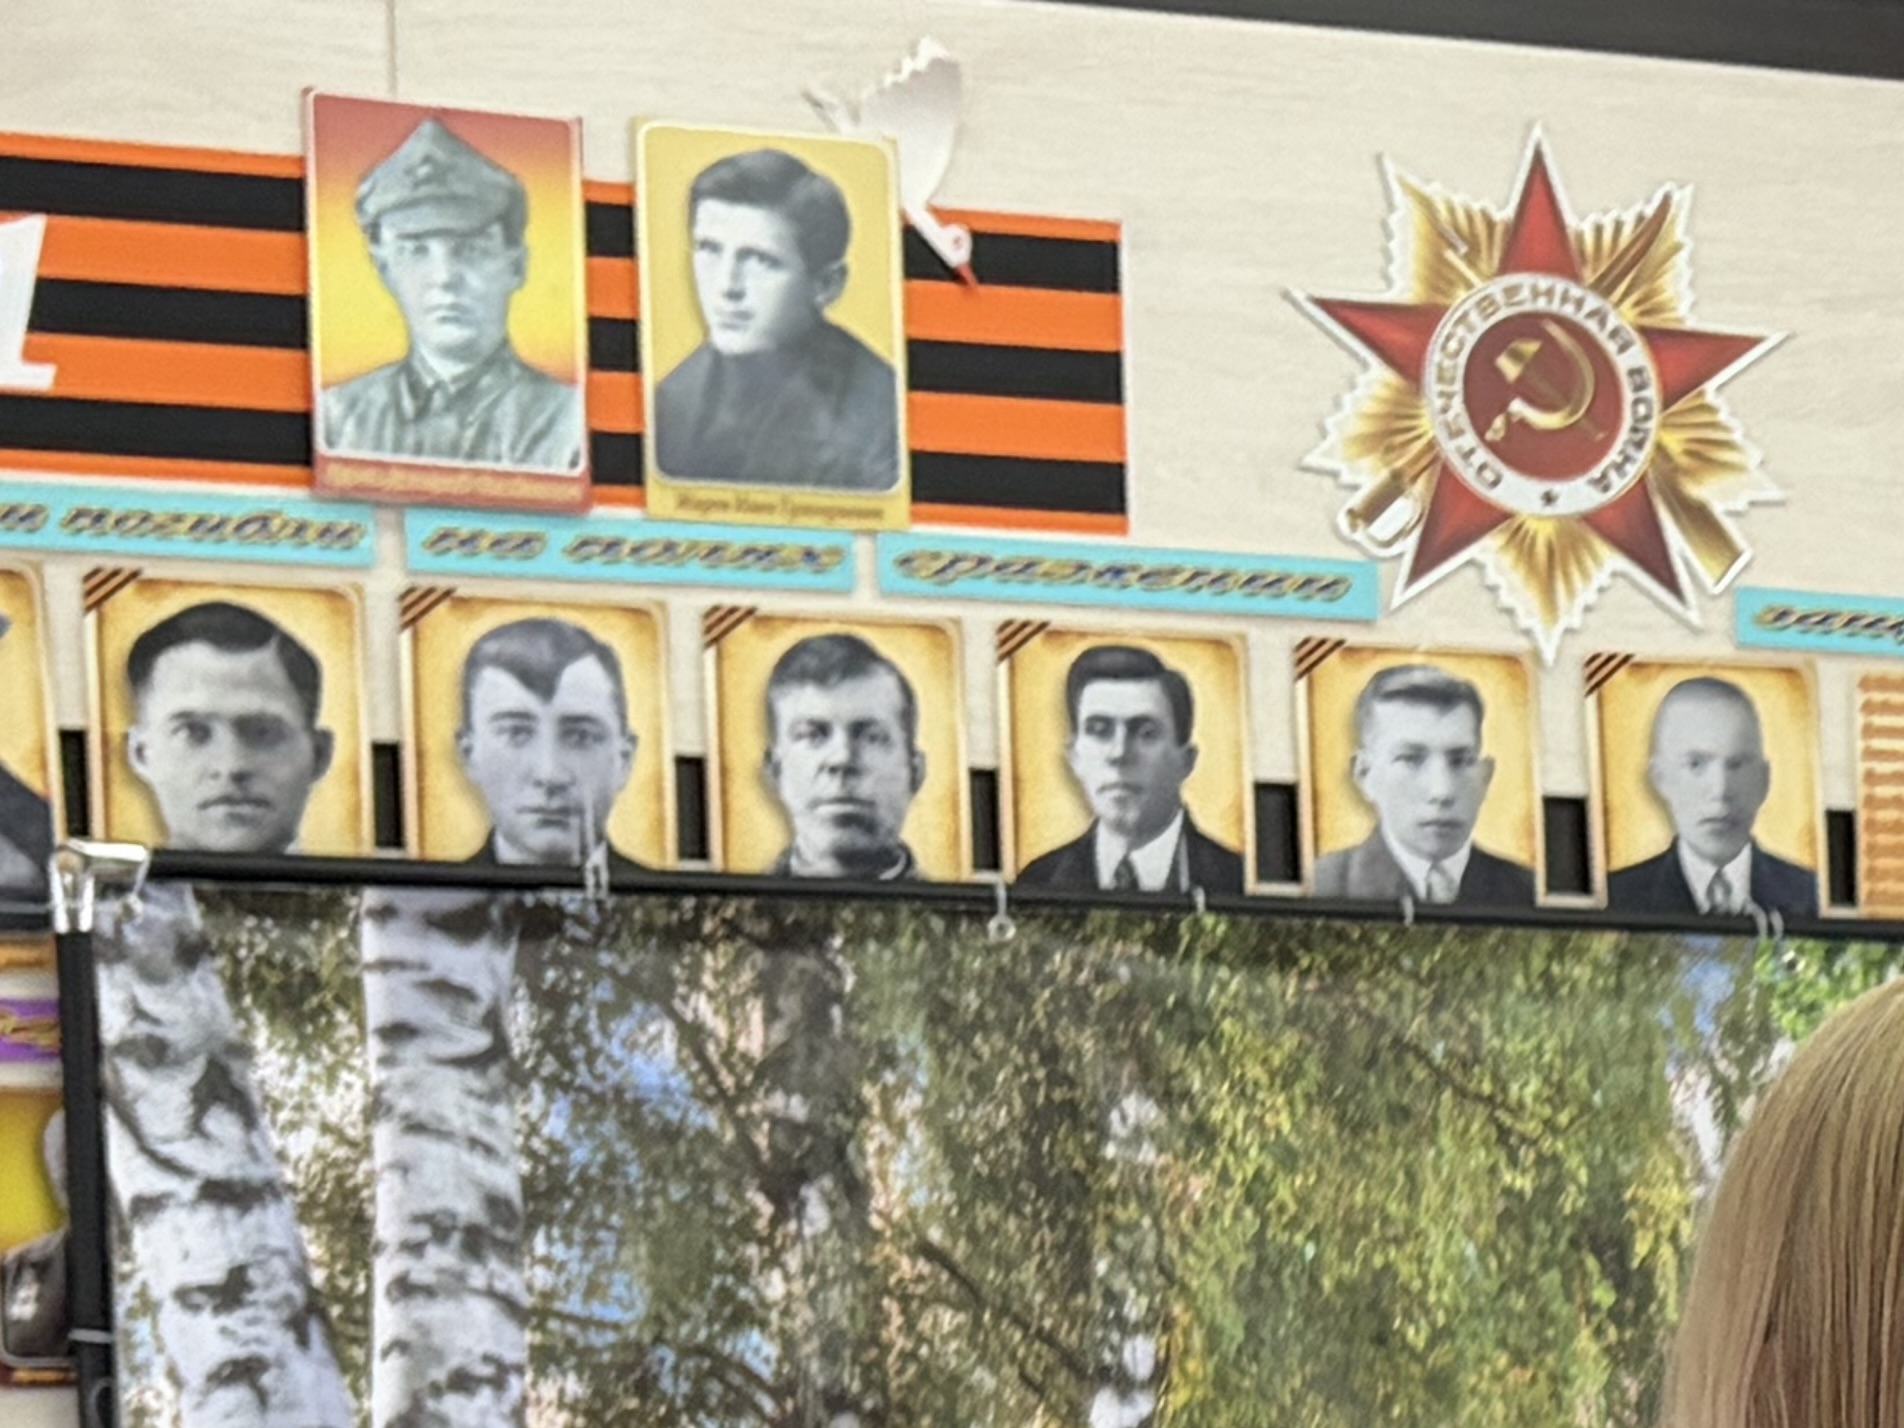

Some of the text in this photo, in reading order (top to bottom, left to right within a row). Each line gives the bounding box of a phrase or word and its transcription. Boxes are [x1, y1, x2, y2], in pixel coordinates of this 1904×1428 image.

[1434, 282, 1654, 494] ОТЕЧЕСТВЕННАЯ ВОЙНА
[60, 506, 368, 549] погибли
[421, 526, 548, 560] на
